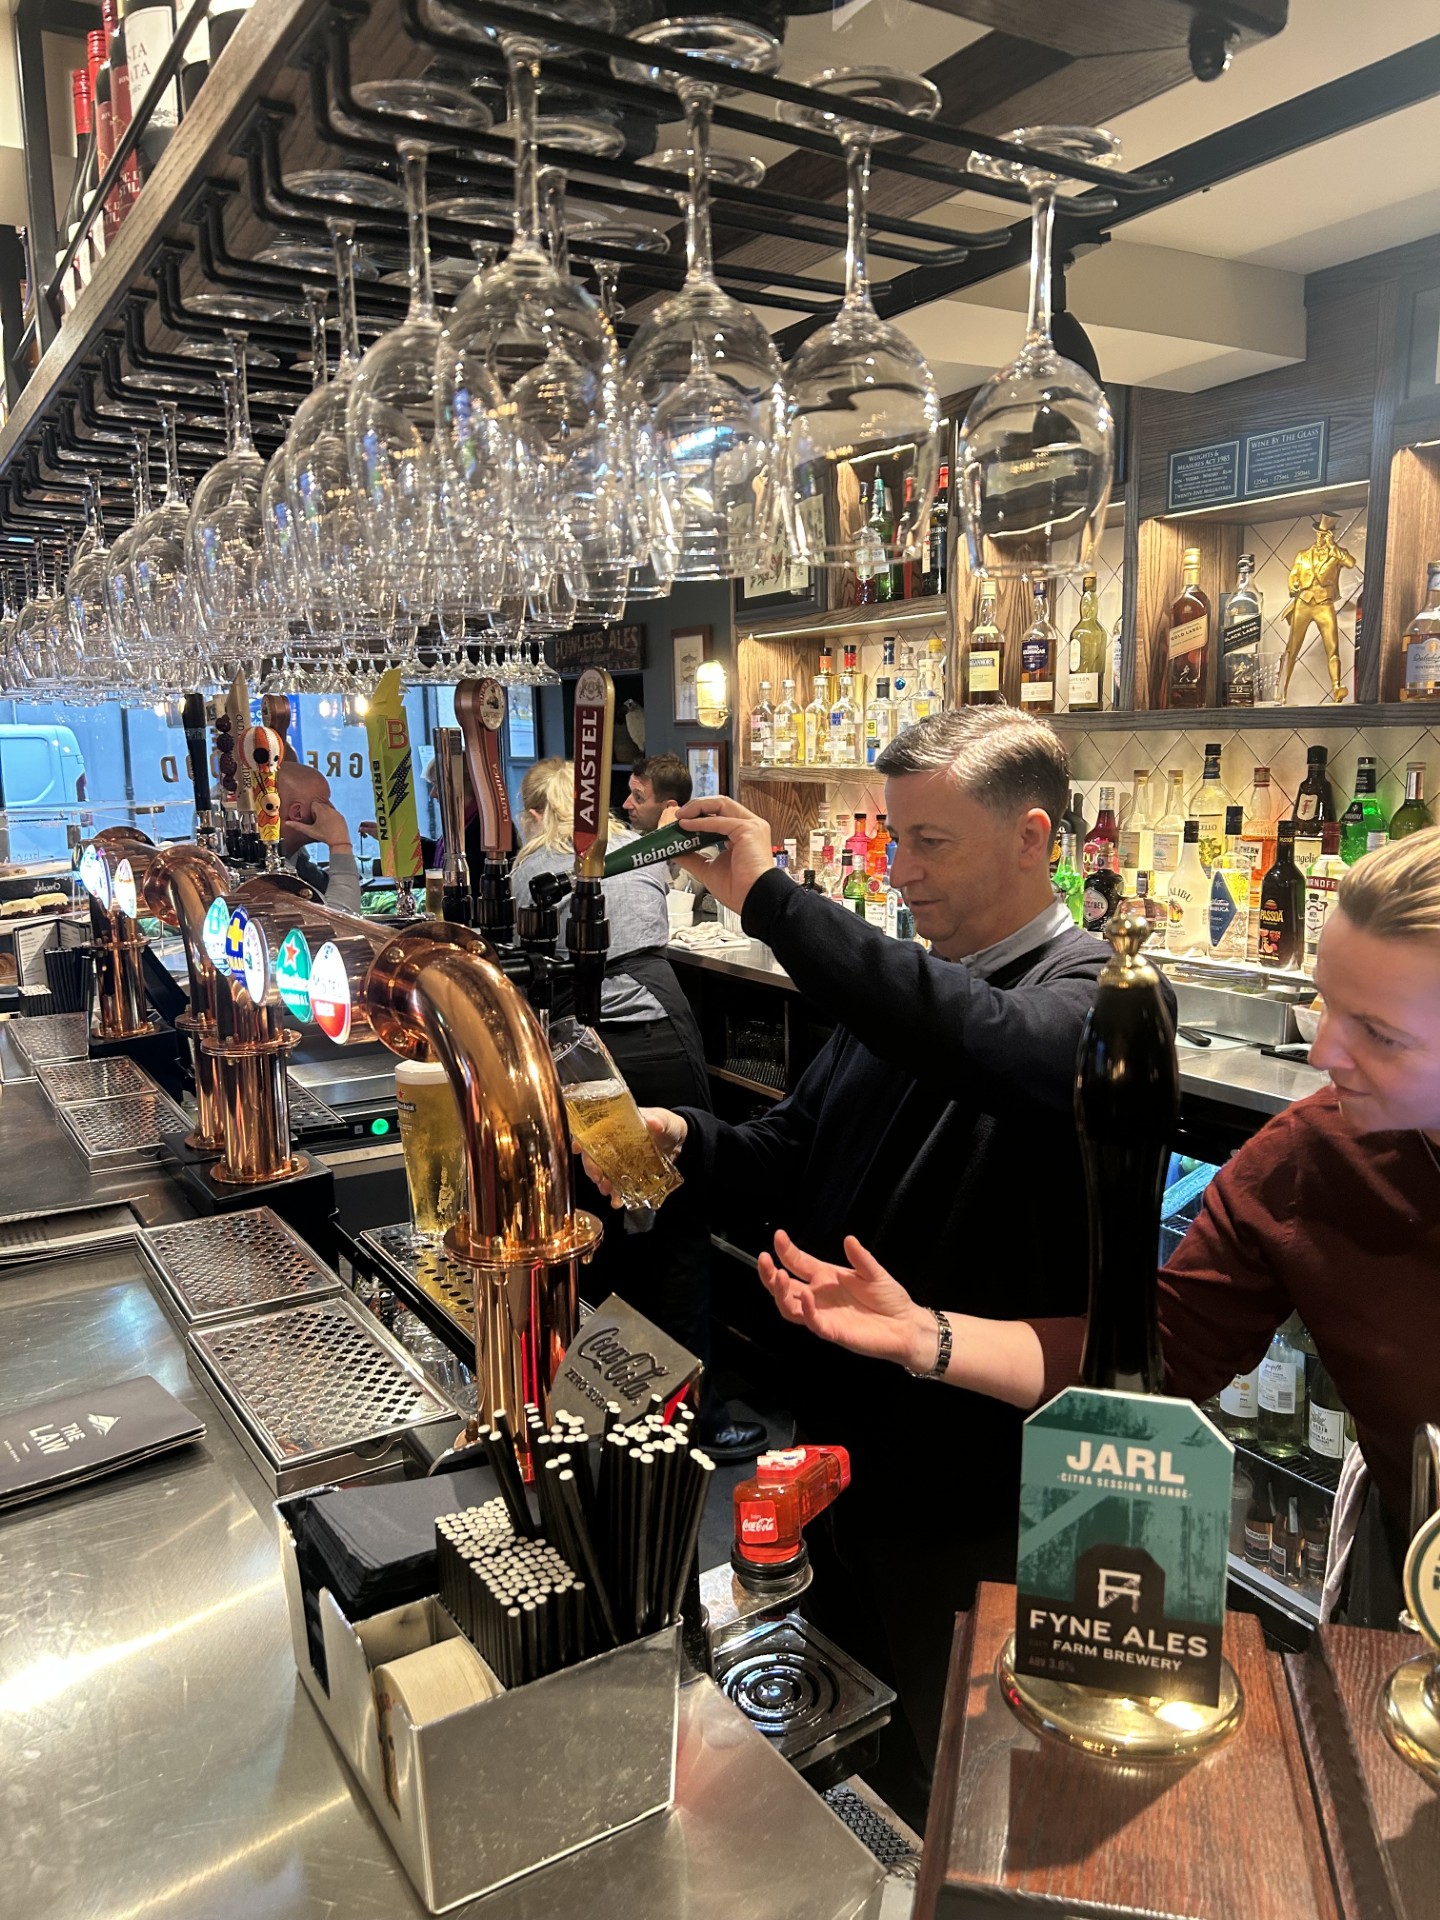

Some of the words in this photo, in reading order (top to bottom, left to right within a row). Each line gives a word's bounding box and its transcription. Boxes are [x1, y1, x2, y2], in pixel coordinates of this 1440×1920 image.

[1251, 439, 1270, 449] WINE
[1272, 436, 1280, 446] BY
[1282, 433, 1296, 443] THE
[1297, 429, 1319, 440] GLASS
[1177, 460, 1205, 470] MEASURES
[1206, 457, 1216, 466] ACT
[1188, 452, 1213, 462] WEIGHTS
[386, 719, 409, 749] B
[580, 710, 598, 826] AMSTEL
[372, 760, 389, 841] BRIXTON
[632, 835, 700, 868] Heineken
[1168, 888, 1192, 903] ALIBU
[564, 1368, 588, 1392] ZERO
[586, 1387, 608, 1413] SUGA
[28, 1424, 70, 1454] LAW
[60, 1422, 86, 1442] THE
[1066, 1440, 1185, 1484] JARL
[1061, 1472, 1092, 1486] CITRA
[1097, 1478, 1142, 1492] SESSION
[1147, 1485, 1188, 1499] BLONDE
[1029, 1609, 1112, 1643] FYNE
[1122, 1626, 1208, 1658] ALES
[1053, 1639, 1098, 1657] FARM
[1103, 1648, 1183, 1672] BREWERY
